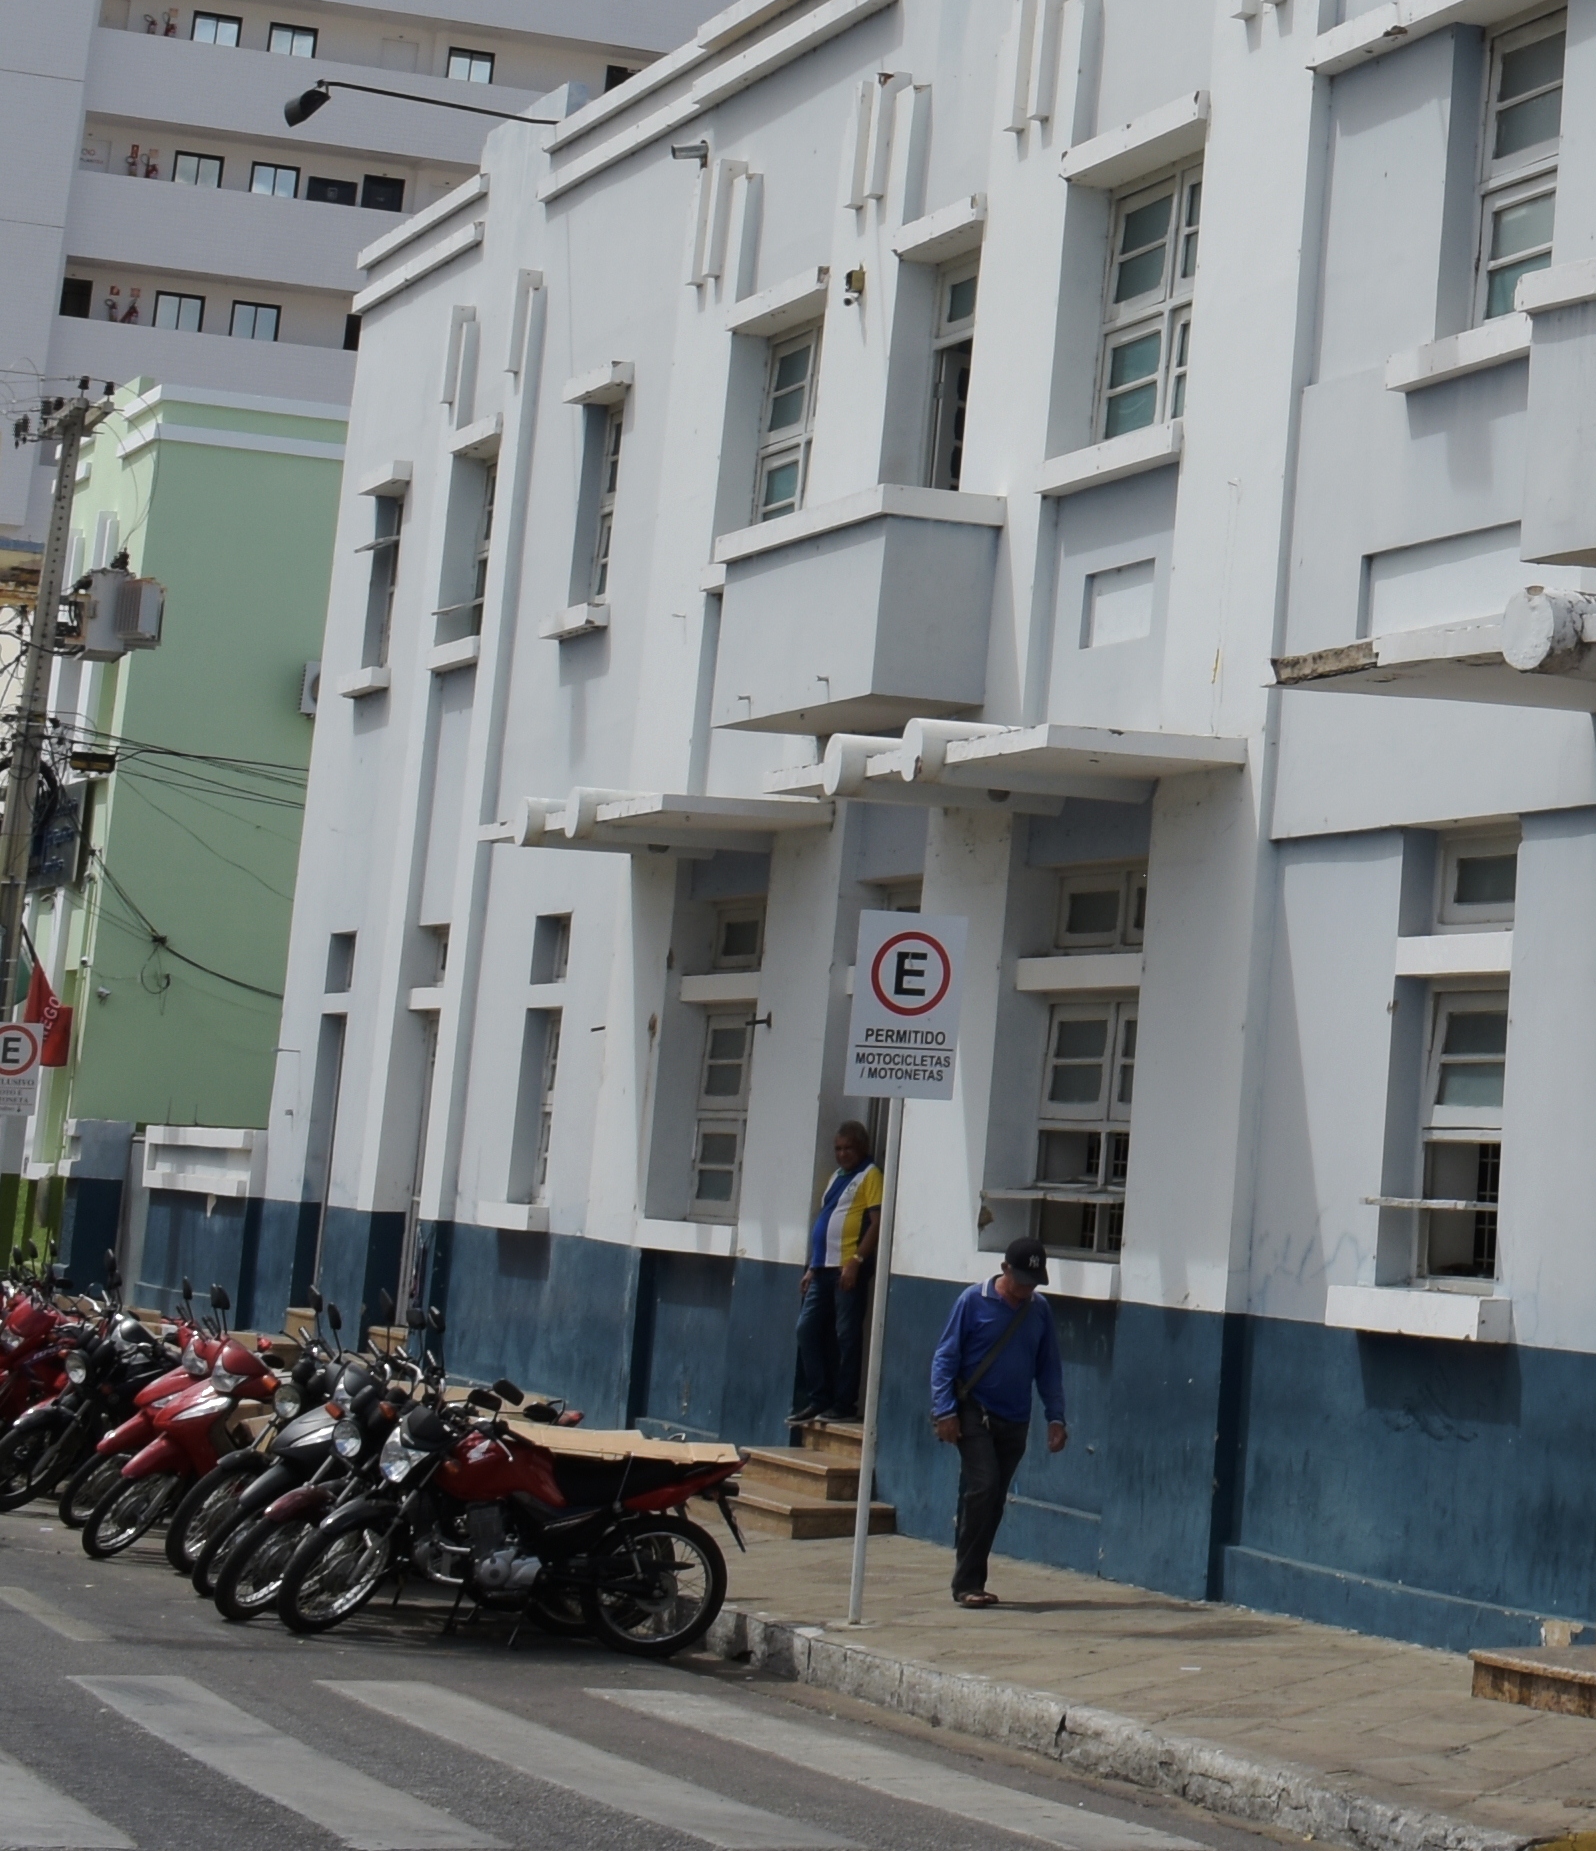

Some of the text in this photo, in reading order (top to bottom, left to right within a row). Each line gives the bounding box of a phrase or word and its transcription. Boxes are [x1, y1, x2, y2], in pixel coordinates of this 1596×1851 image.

[894, 951, 928, 997] E
[864, 1028, 946, 1046] PERMITIDO
[1, 1036, 21, 1064] E
[855, 1052, 951, 1068] MOTOCICLETAS
[867, 1067, 944, 1082] MOTONETAS
